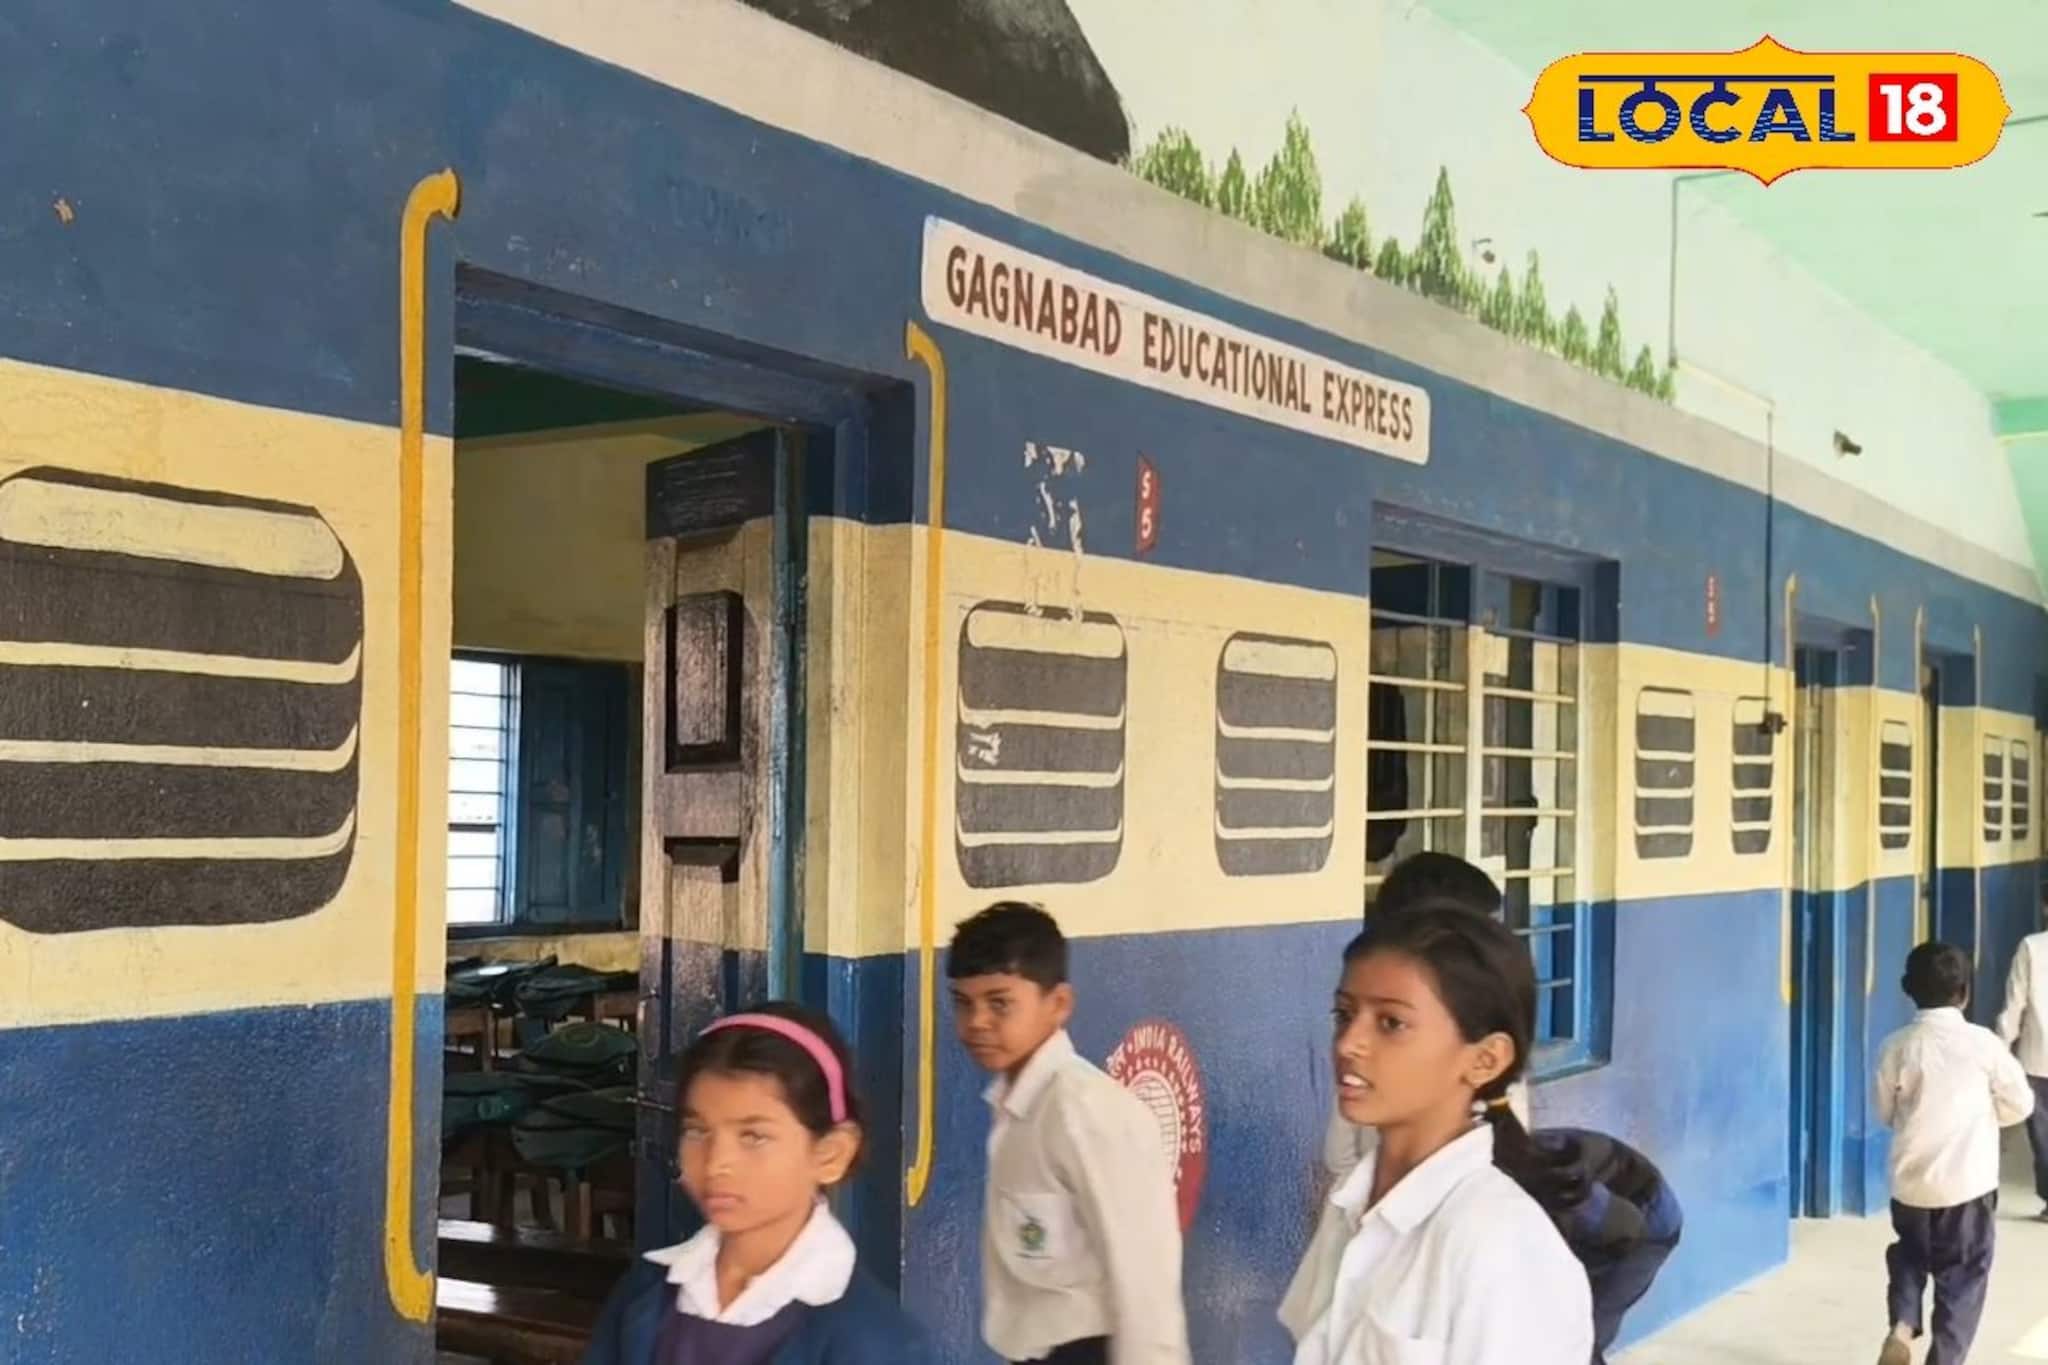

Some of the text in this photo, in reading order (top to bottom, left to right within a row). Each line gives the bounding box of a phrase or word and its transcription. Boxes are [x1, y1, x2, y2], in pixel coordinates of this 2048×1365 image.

[946, 244, 1413, 442] GAGNABAD EDUCATIONAL EXPRESS
